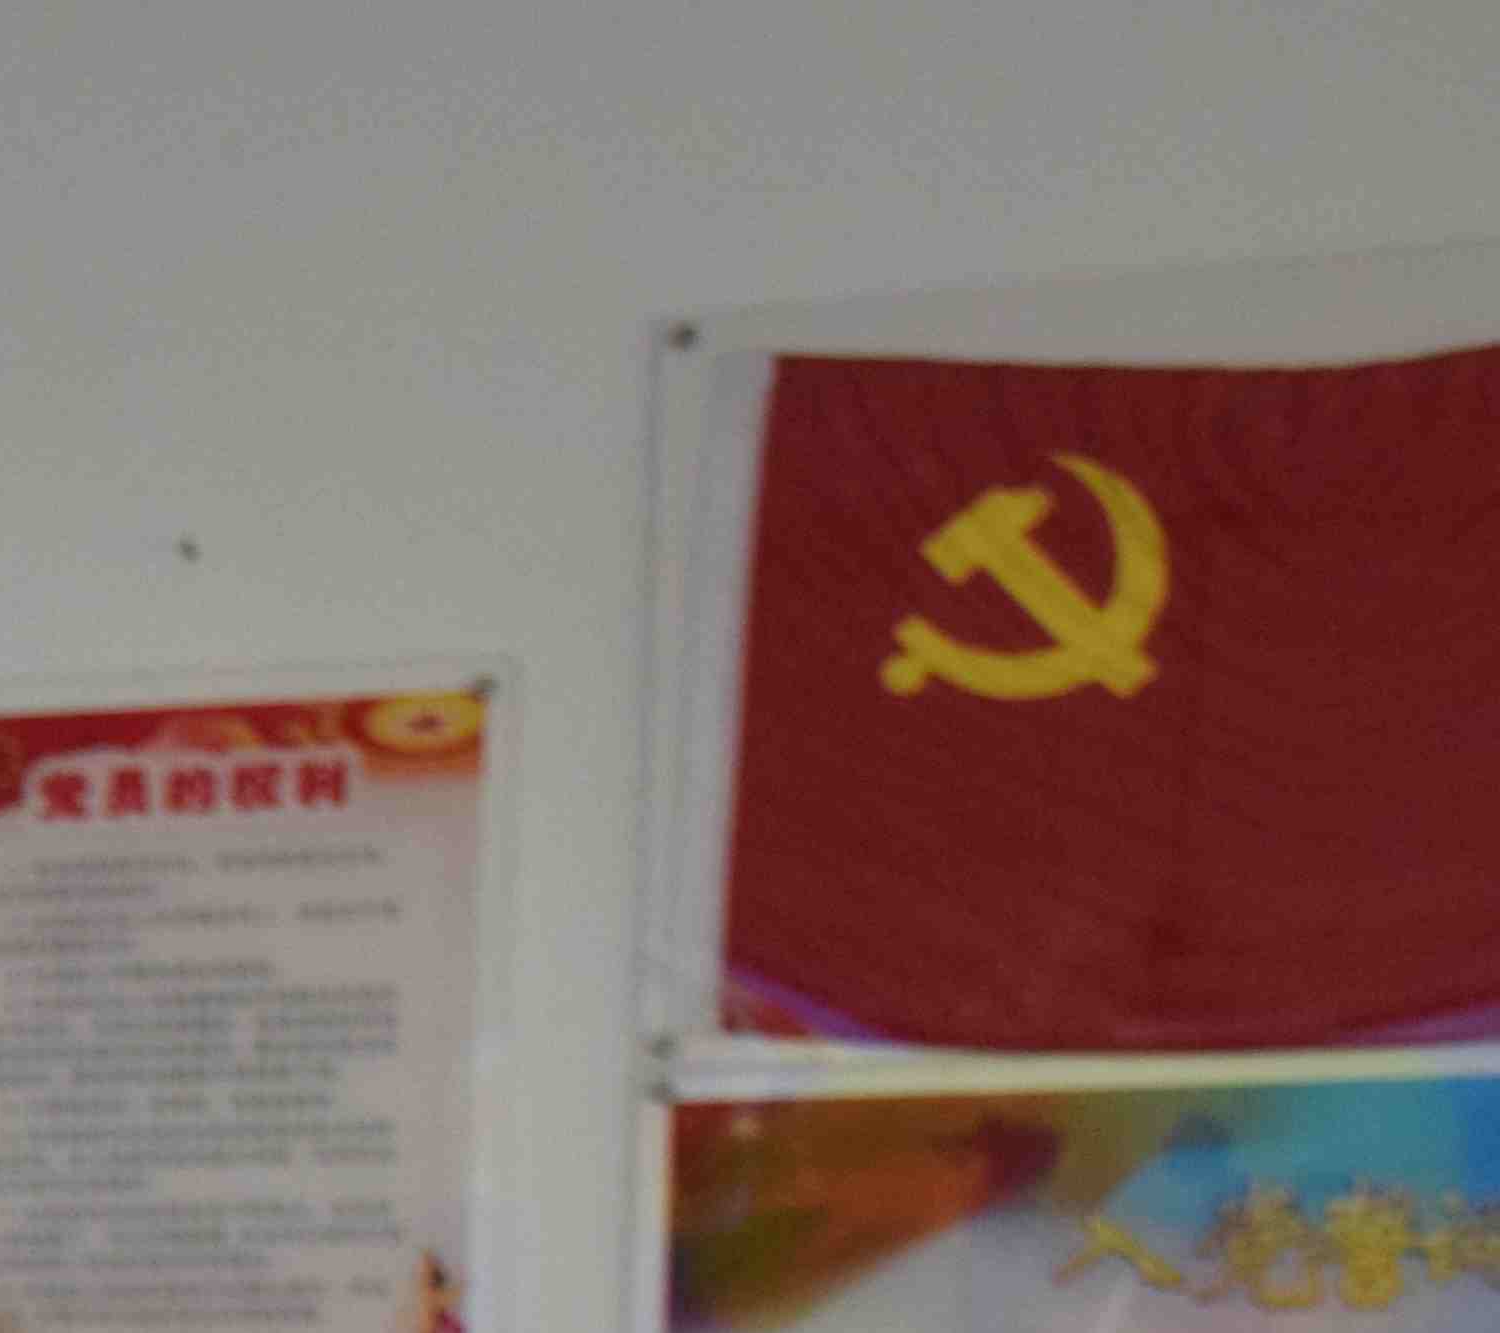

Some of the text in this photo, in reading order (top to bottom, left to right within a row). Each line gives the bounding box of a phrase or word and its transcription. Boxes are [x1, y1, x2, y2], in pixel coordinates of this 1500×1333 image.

[40, 761, 349, 821] 党员的权利
